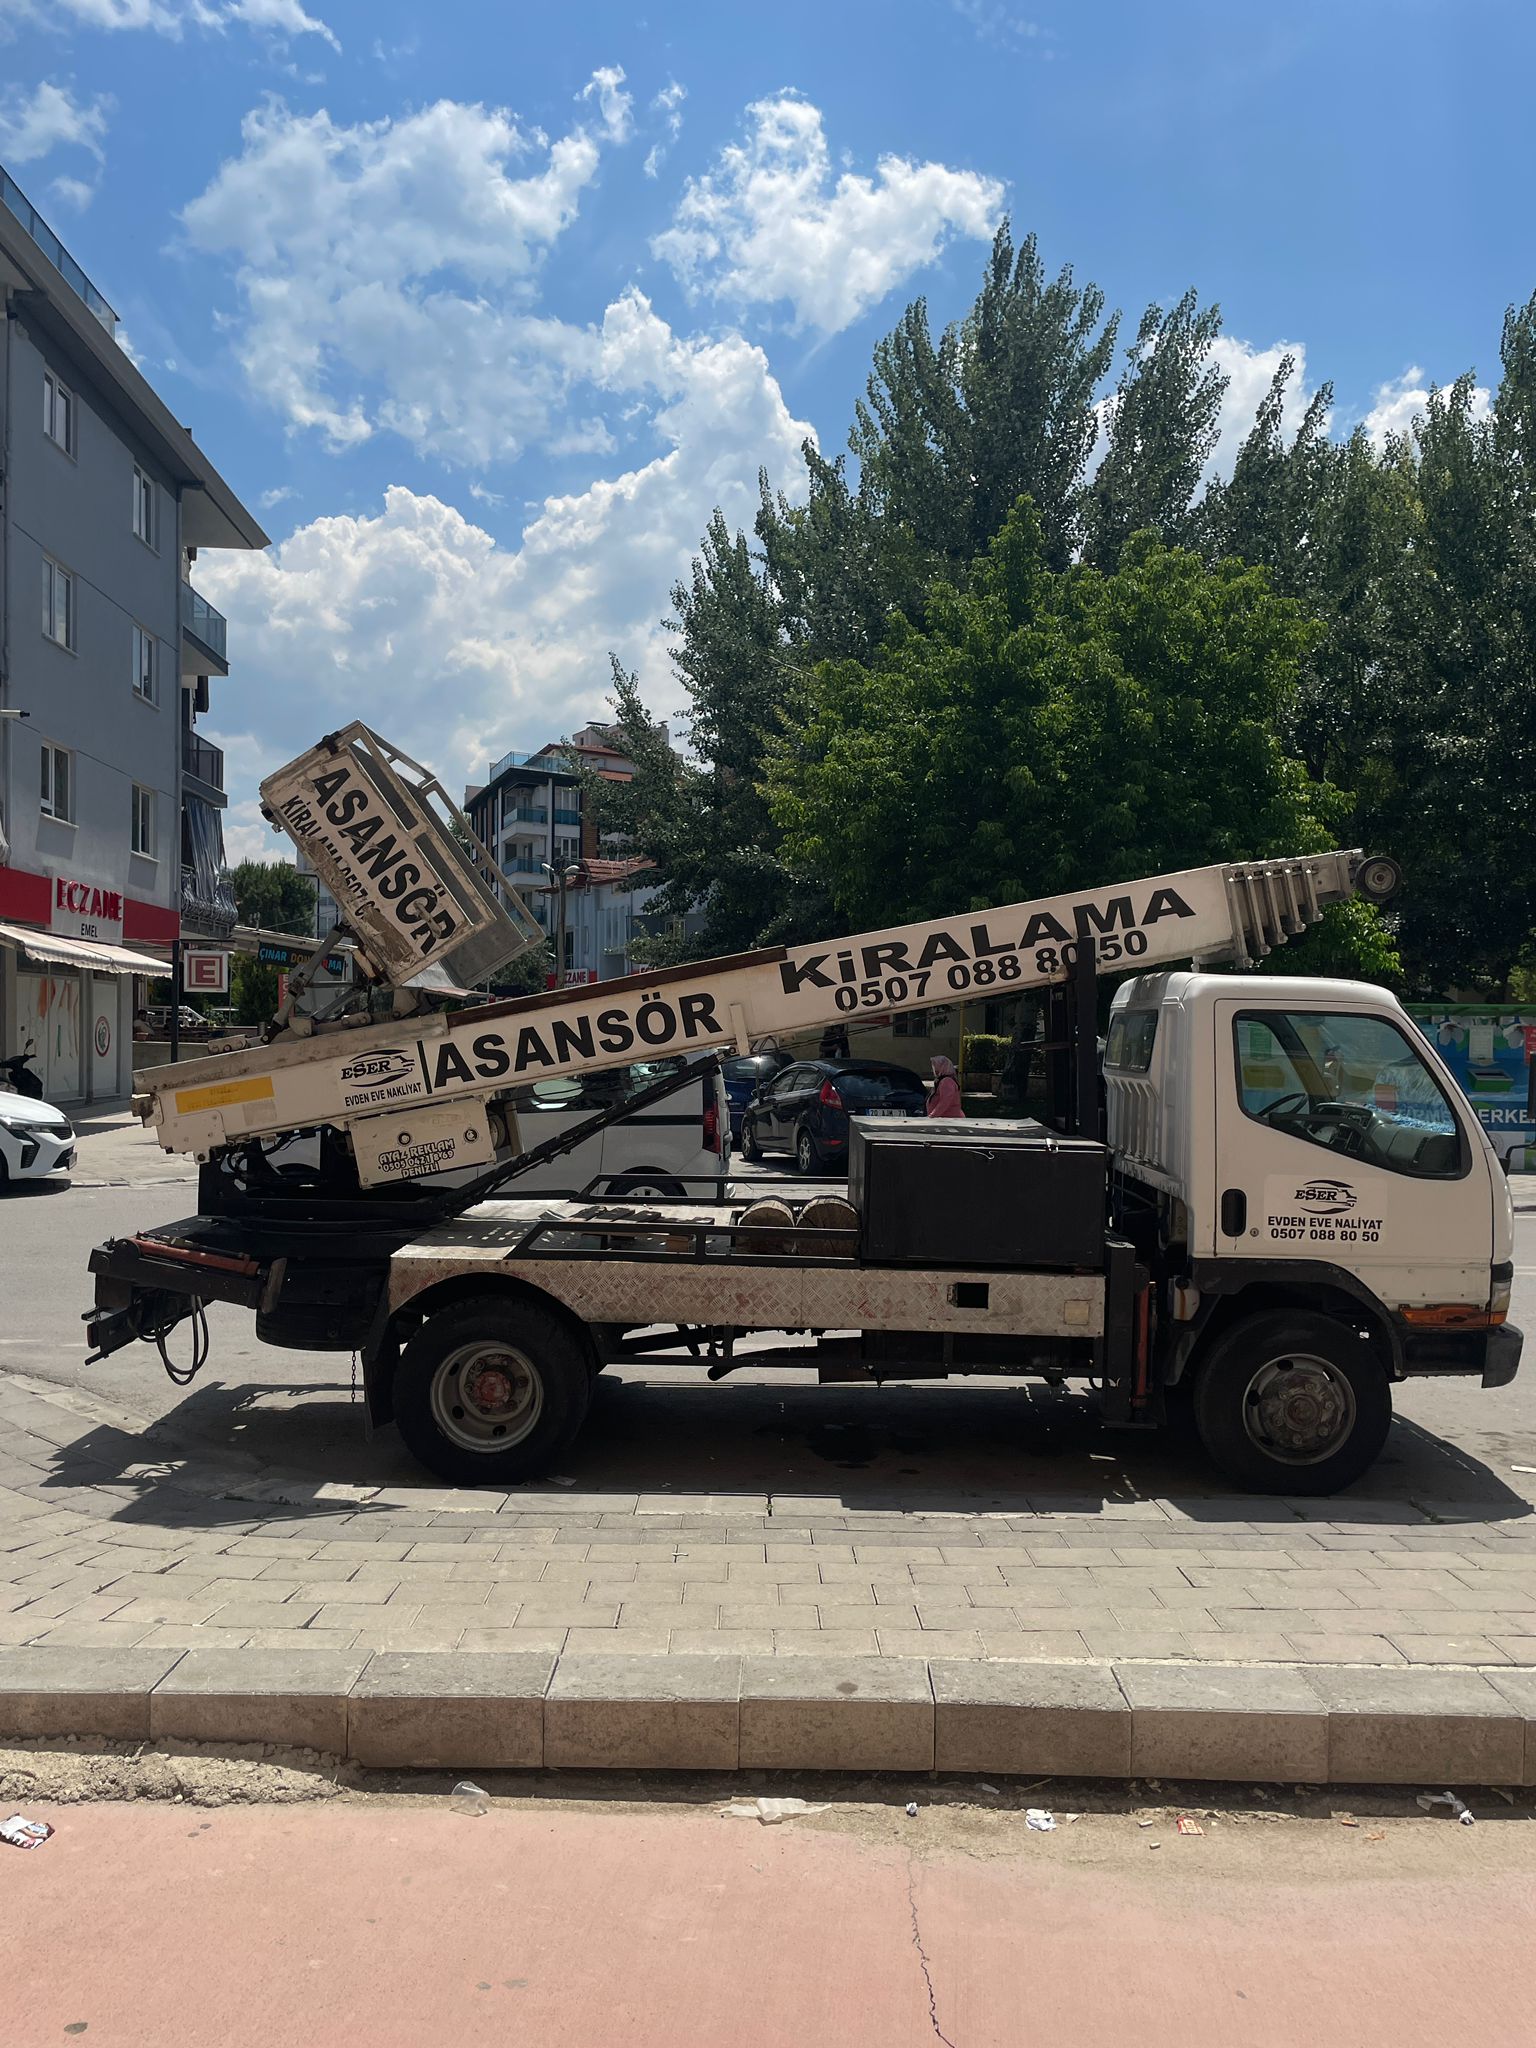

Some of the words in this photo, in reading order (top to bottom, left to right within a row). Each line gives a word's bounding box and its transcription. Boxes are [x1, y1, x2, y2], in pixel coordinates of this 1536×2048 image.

[312, 767, 457, 955] ASANSÖR
[56, 877, 123, 922] ECZANE
[80, 923, 98, 938] EMEL
[259, 948, 287, 961] ÇINAR
[195, 960, 216, 984] E
[834, 971, 932, 1011] 0507
[947, 954, 1022, 990] 088
[1035, 943, 1079, 973] 80
[1099, 929, 1148, 961] 50
[434, 991, 724, 1089] ASANSÖR
[344, 1092, 370, 1107] EVDEN
[371, 1089, 385, 1101] EVE
[387, 1082, 422, 1098] NAKLİYAT
[378, 1149, 408, 1165] AYAZ
[409, 1138, 455, 1157] REKLAM
[1268, 1216, 1306, 1227] EVDEN
[1309, 1217, 1332, 1228] EVE
[1335, 1217, 1383, 1230] NALİYAT
[1271, 1228, 1305, 1239] 0507
[1310, 1229, 1335, 1241] 088
[1340, 1230, 1357, 1241] 80
[1362, 1231, 1379, 1242] 50
